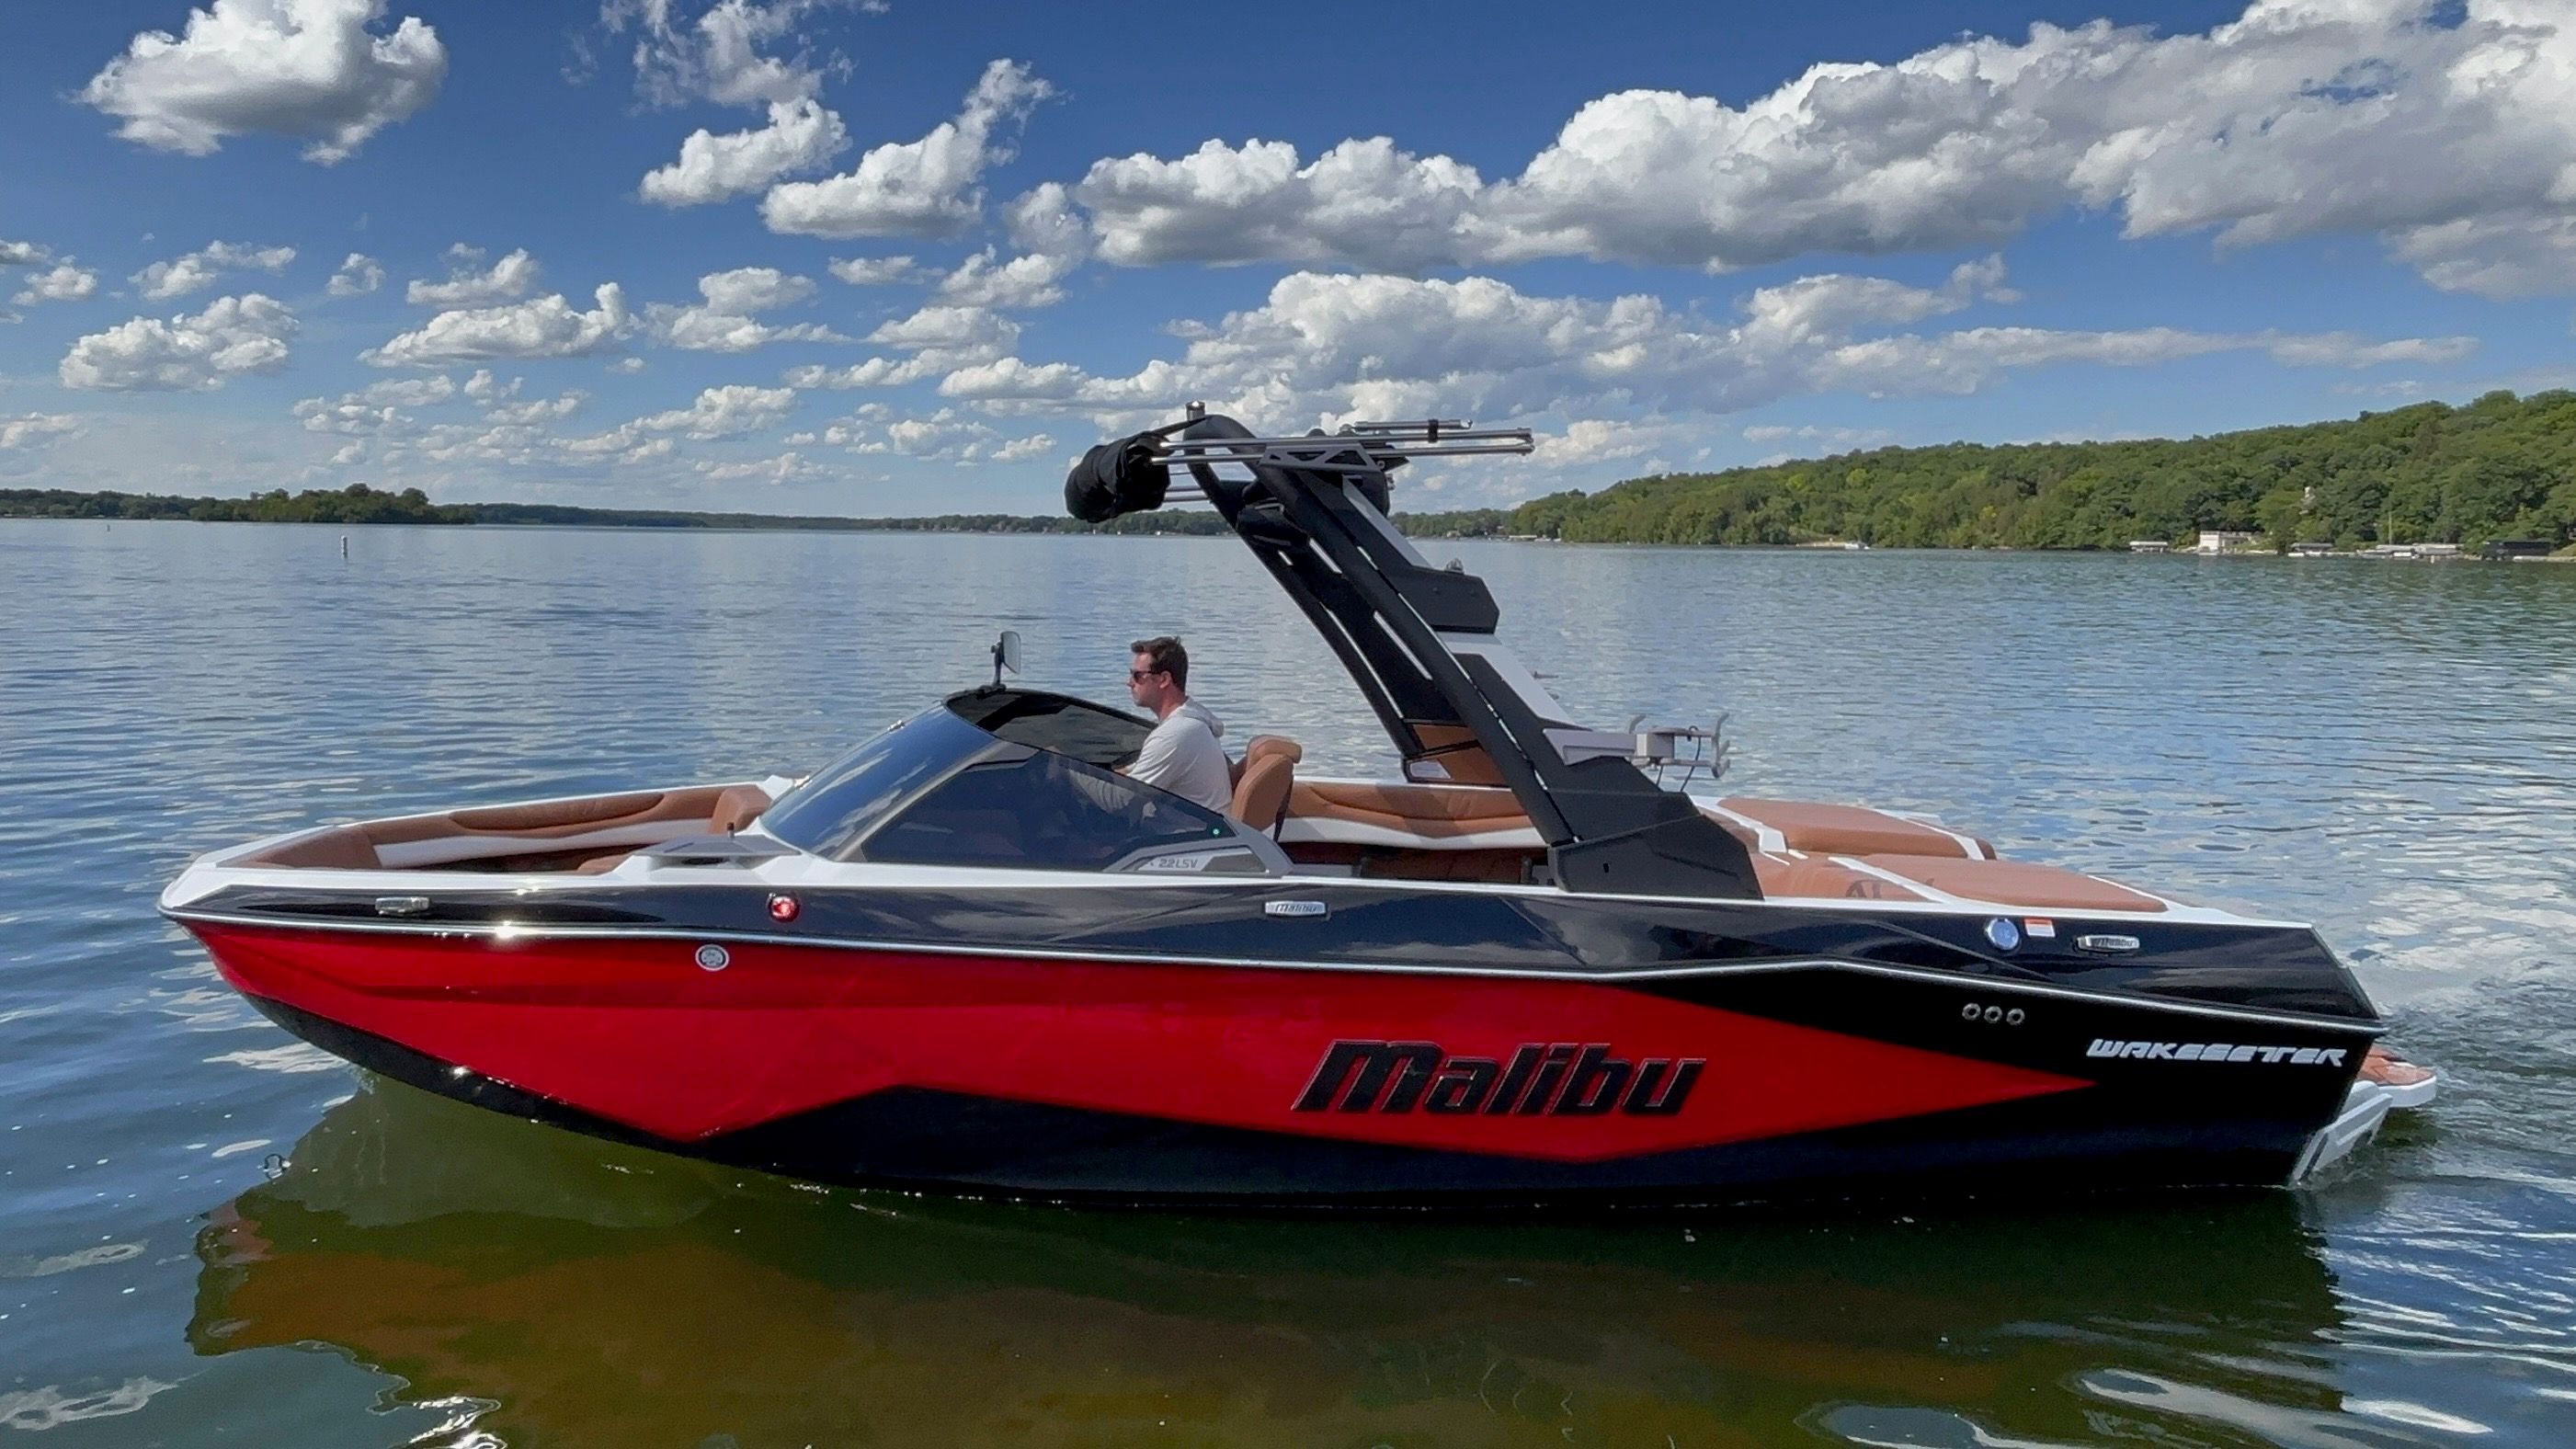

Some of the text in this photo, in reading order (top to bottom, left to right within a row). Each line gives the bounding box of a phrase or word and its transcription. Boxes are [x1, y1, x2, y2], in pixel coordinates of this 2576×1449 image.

[1158, 859, 1198, 869] 22LSV
[2086, 1039, 2347, 1067] WAKESETTER
[1291, 1039, 1707, 1115] Malibu
